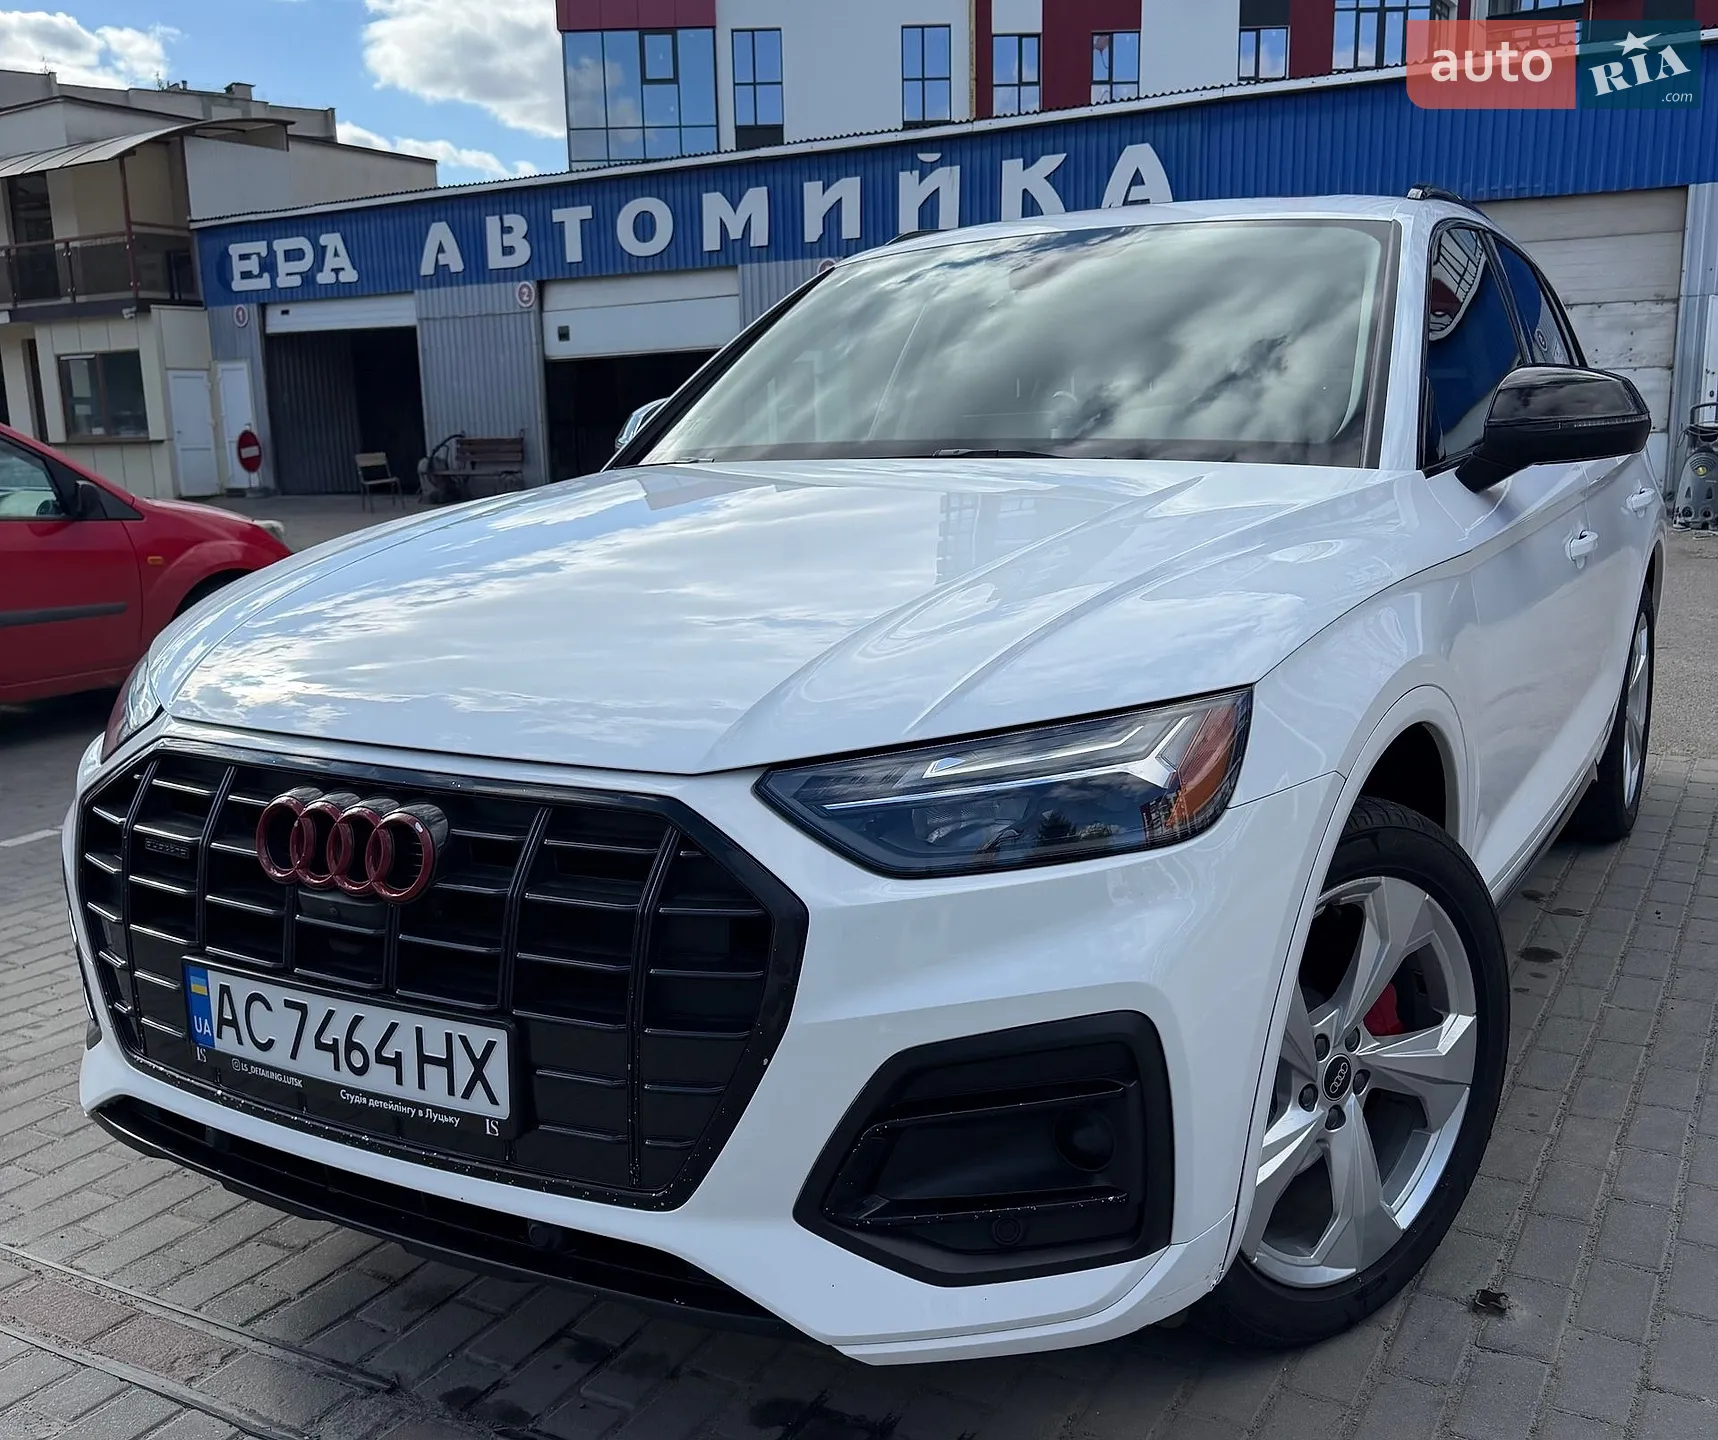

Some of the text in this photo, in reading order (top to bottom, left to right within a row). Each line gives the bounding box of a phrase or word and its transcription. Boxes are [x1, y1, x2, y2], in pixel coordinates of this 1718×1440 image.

[228, 142, 1175, 292] ЕРА АВТОМИЙКА
[193, 1015, 212, 1037] UA
[196, 1047, 207, 1063] LS
[340, 1089, 367, 1104] Студія
[368, 1098, 416, 1118] детейлінгу
[425, 1108, 461, 1127] Луцьку
[485, 1118, 499, 1136] LS
